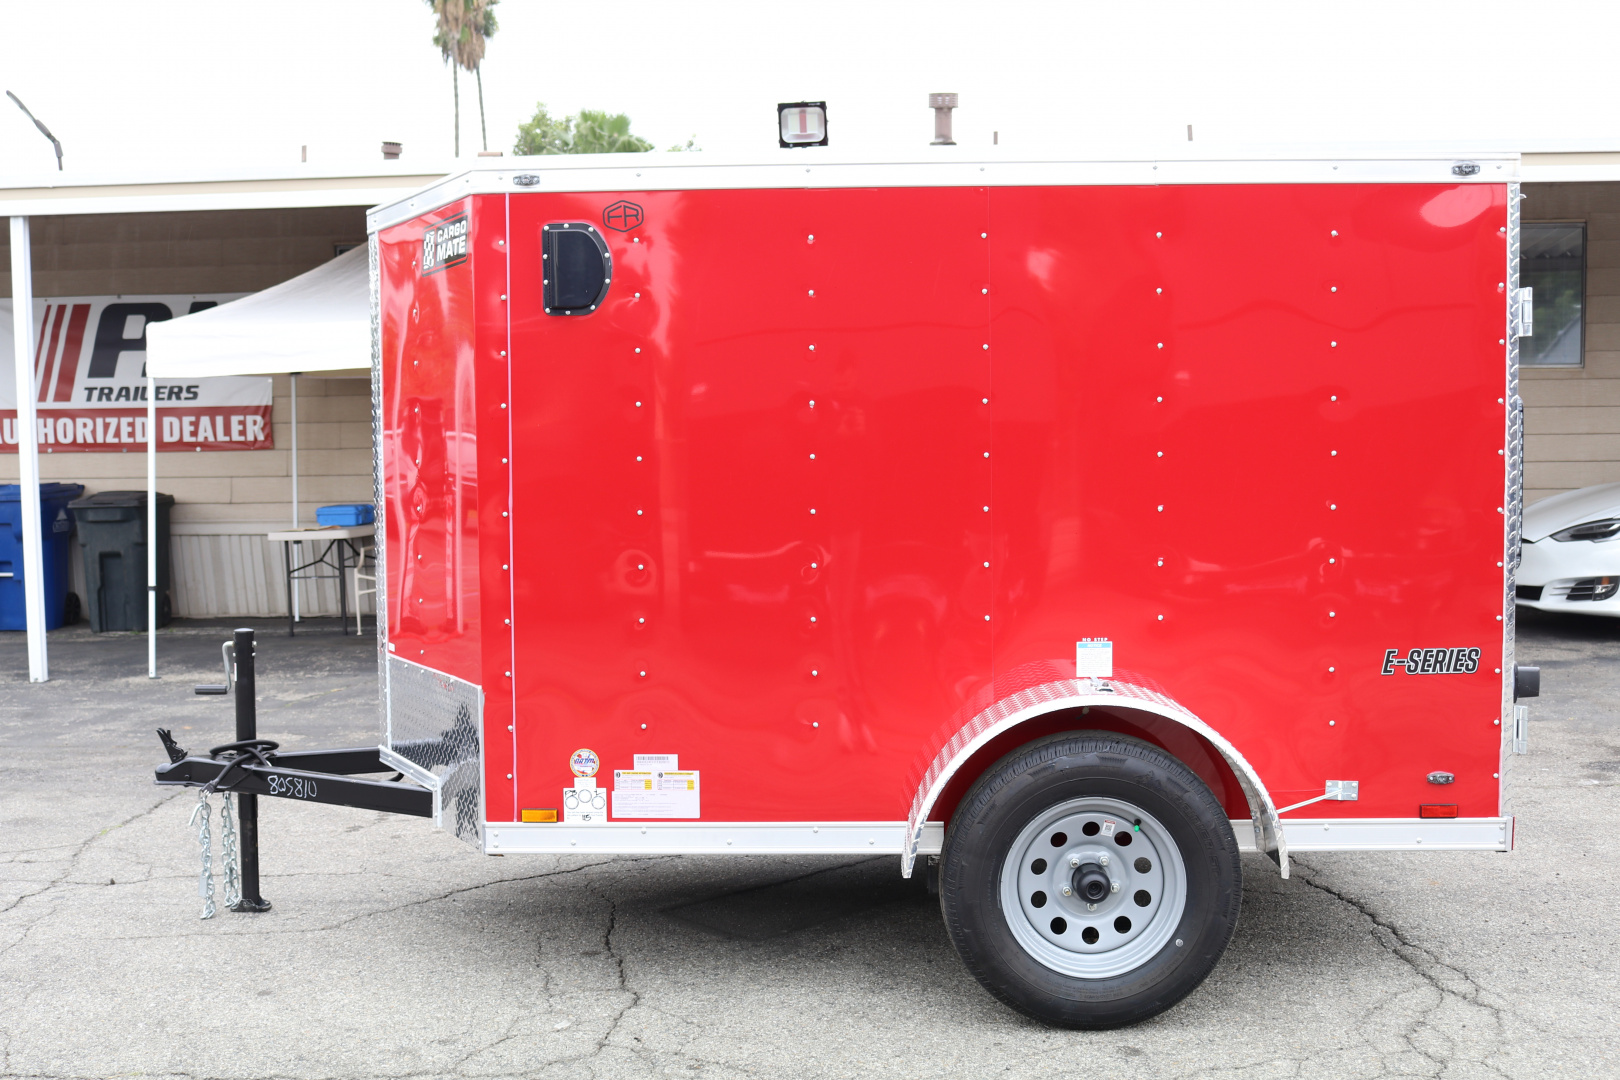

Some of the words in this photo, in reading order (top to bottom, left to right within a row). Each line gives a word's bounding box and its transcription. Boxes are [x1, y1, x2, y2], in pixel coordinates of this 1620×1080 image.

[437, 219, 467, 243] CARGO
[436, 234, 466, 262] MATE
[83, 385, 200, 402] TRAILERS
[0, 417, 148, 445] UHORIZED
[162, 414, 265, 443] DEALER
[1380, 646, 1482, 676] E-SERIES
[267, 775, 318, 799] 805810
